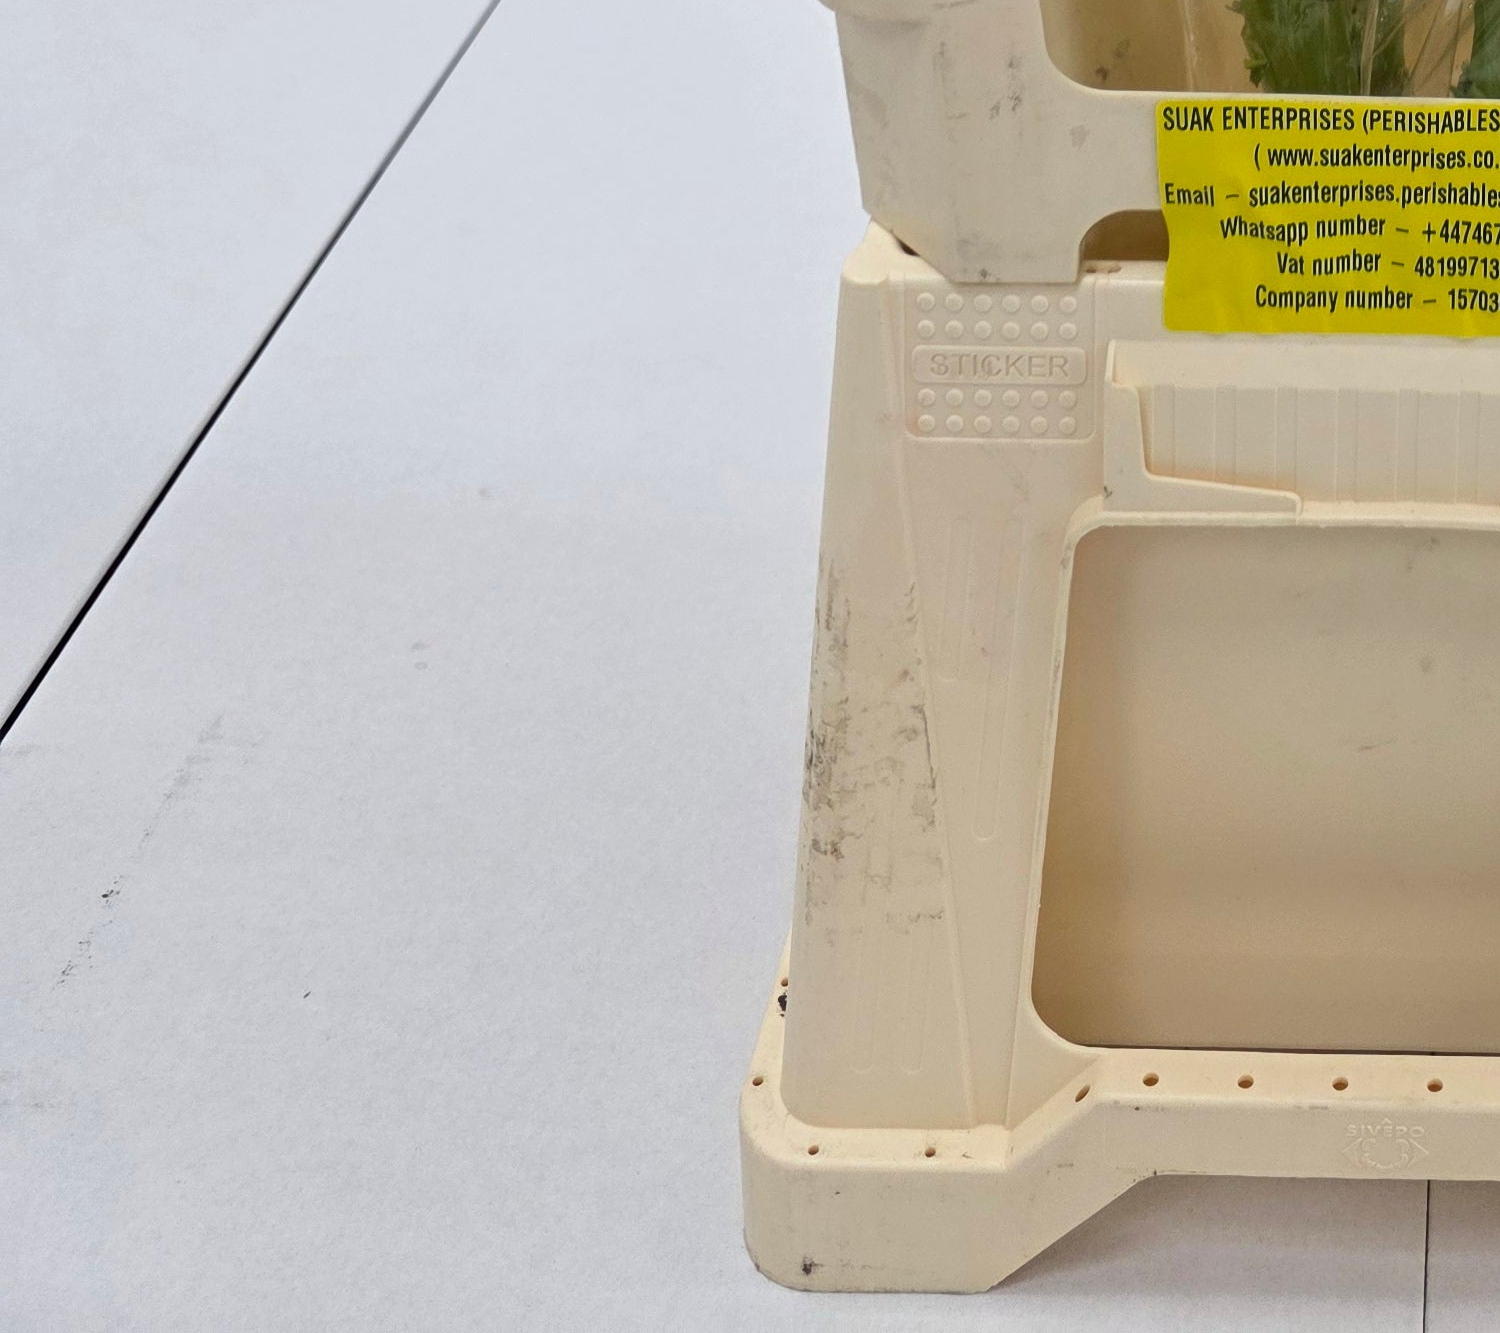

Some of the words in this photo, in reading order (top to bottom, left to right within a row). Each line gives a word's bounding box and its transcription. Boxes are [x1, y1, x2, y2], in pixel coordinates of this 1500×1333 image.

[1163, 107, 1214, 131] SUAK
[1222, 107, 1355, 132] ENTERPRISES
[1165, 183, 1215, 207] Email
[1220, 216, 1308, 246] Whatsapp
[1316, 215, 1386, 239] number
[1277, 252, 1305, 275] Vat
[1313, 251, 1381, 276] number
[1255, 285, 1337, 313] Company
[1345, 287, 1412, 310] number
[930, 353, 1069, 378] STICKER
